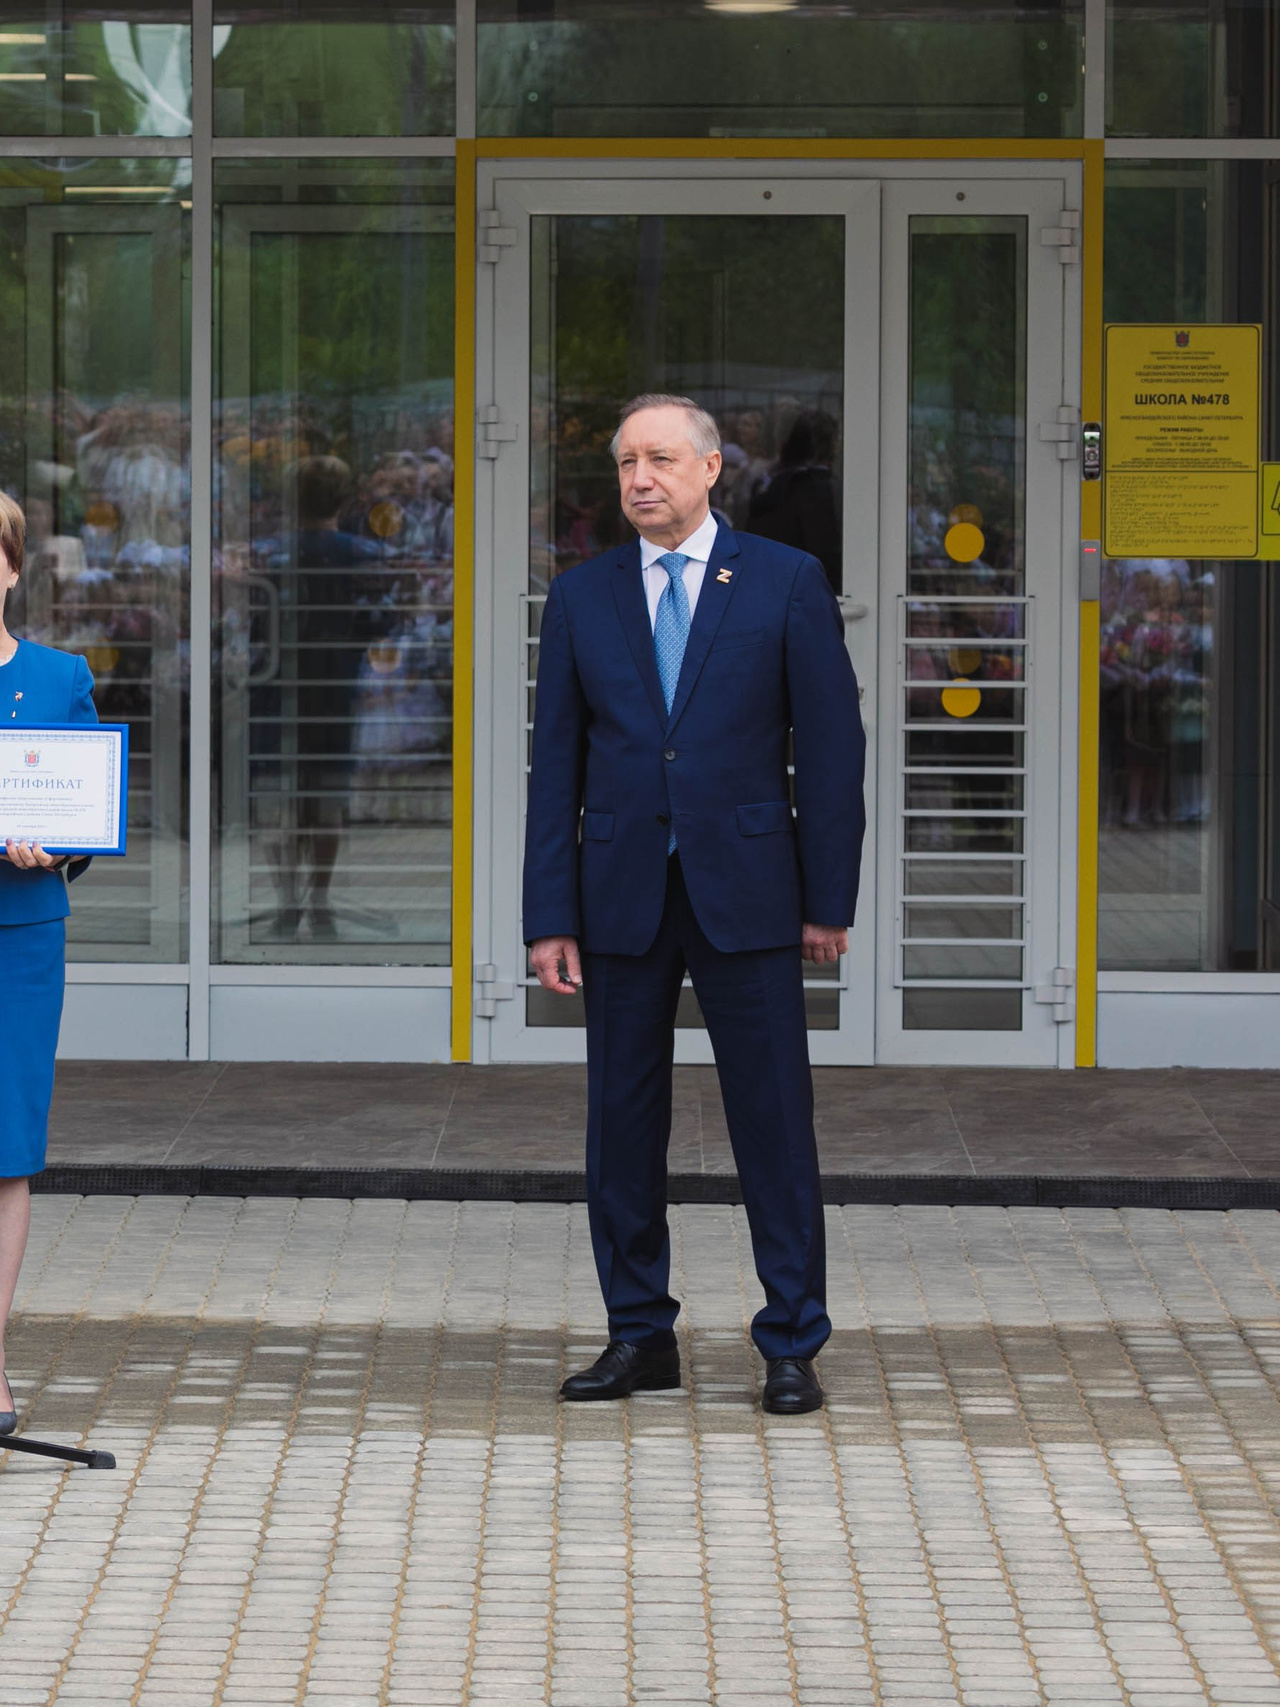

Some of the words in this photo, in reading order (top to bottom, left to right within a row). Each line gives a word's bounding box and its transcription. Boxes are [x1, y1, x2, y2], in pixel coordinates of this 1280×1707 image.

[1134, 393, 1187, 405] ШКОЛА
[1191, 393, 1230, 405] №478
[716, 568, 733, 584] Z
